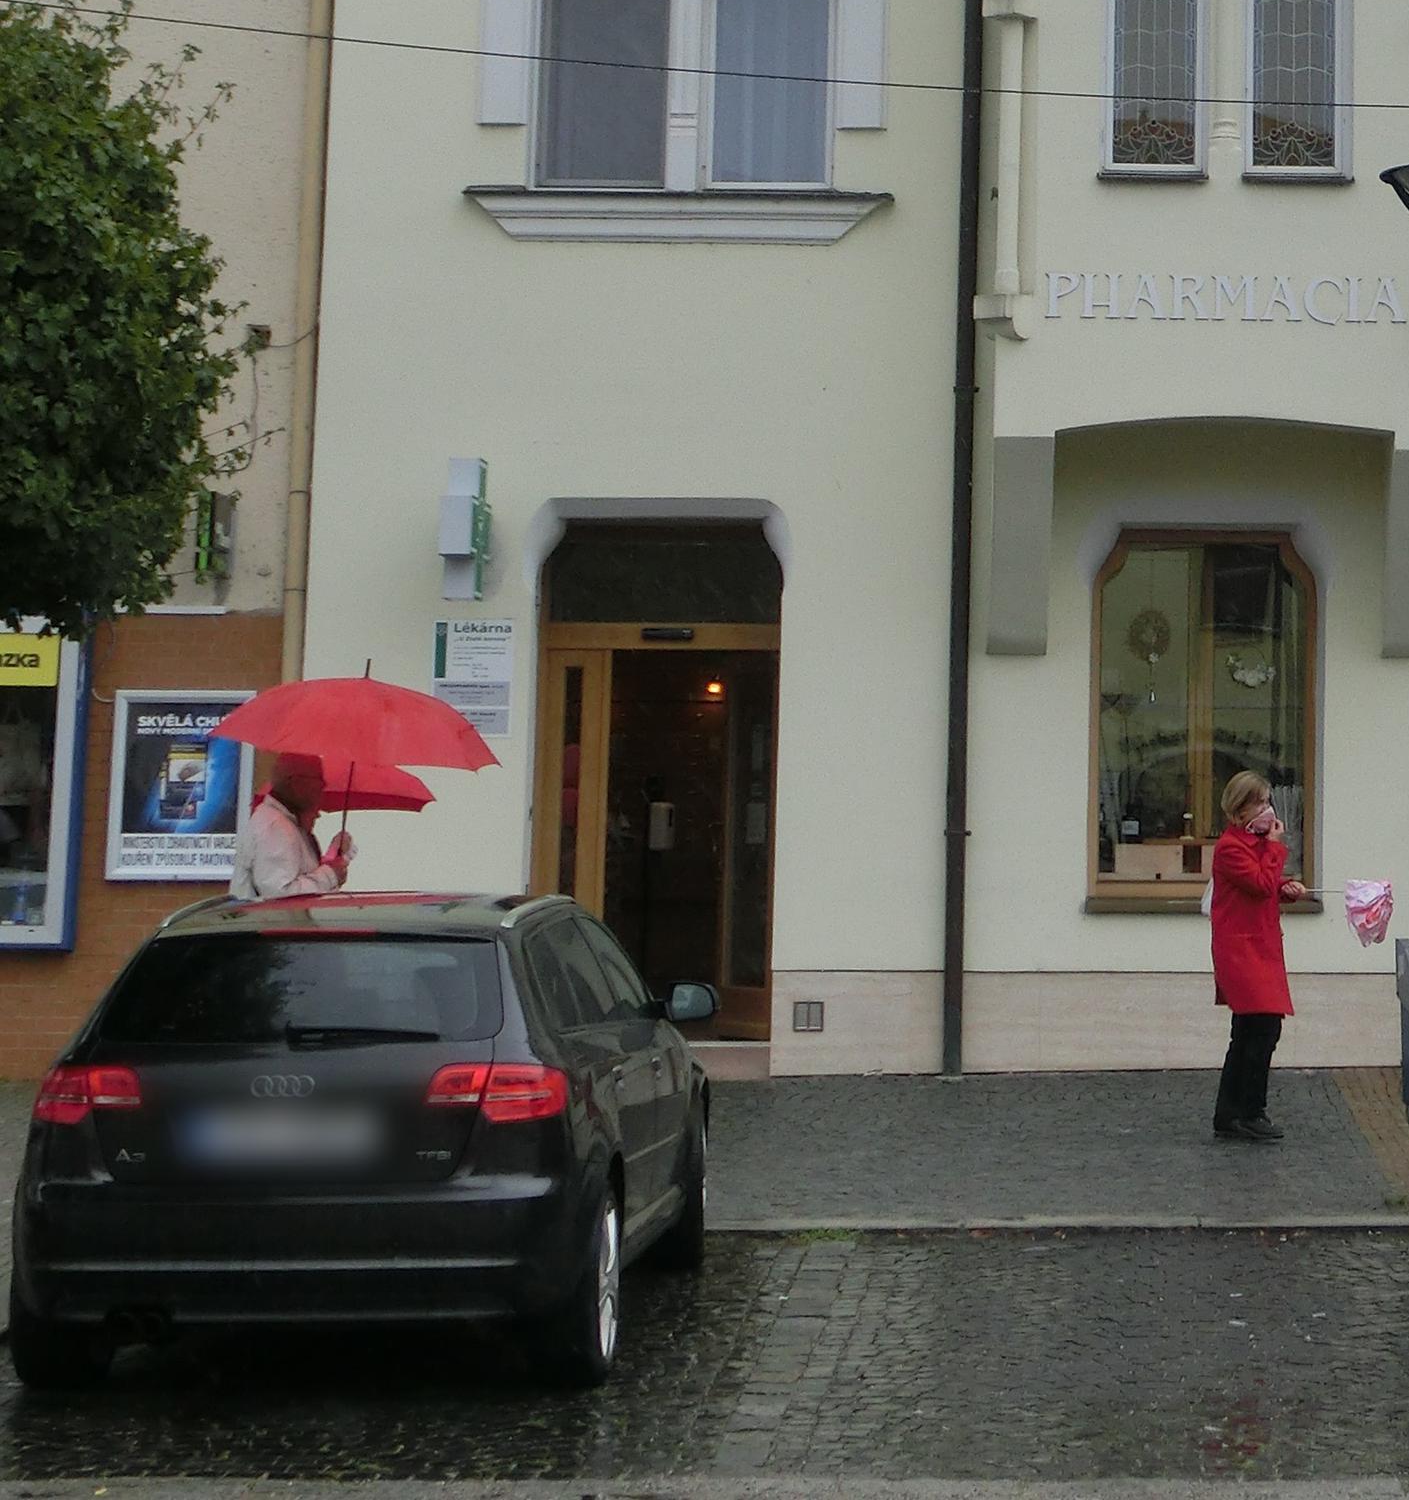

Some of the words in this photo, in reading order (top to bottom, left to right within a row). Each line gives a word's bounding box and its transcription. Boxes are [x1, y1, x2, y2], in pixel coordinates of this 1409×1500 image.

[1044, 272, 1408, 326] PHARMACIA
[454, 621, 513, 633] Lékárna
[137, 713, 194, 727] SKVĚLÁ
